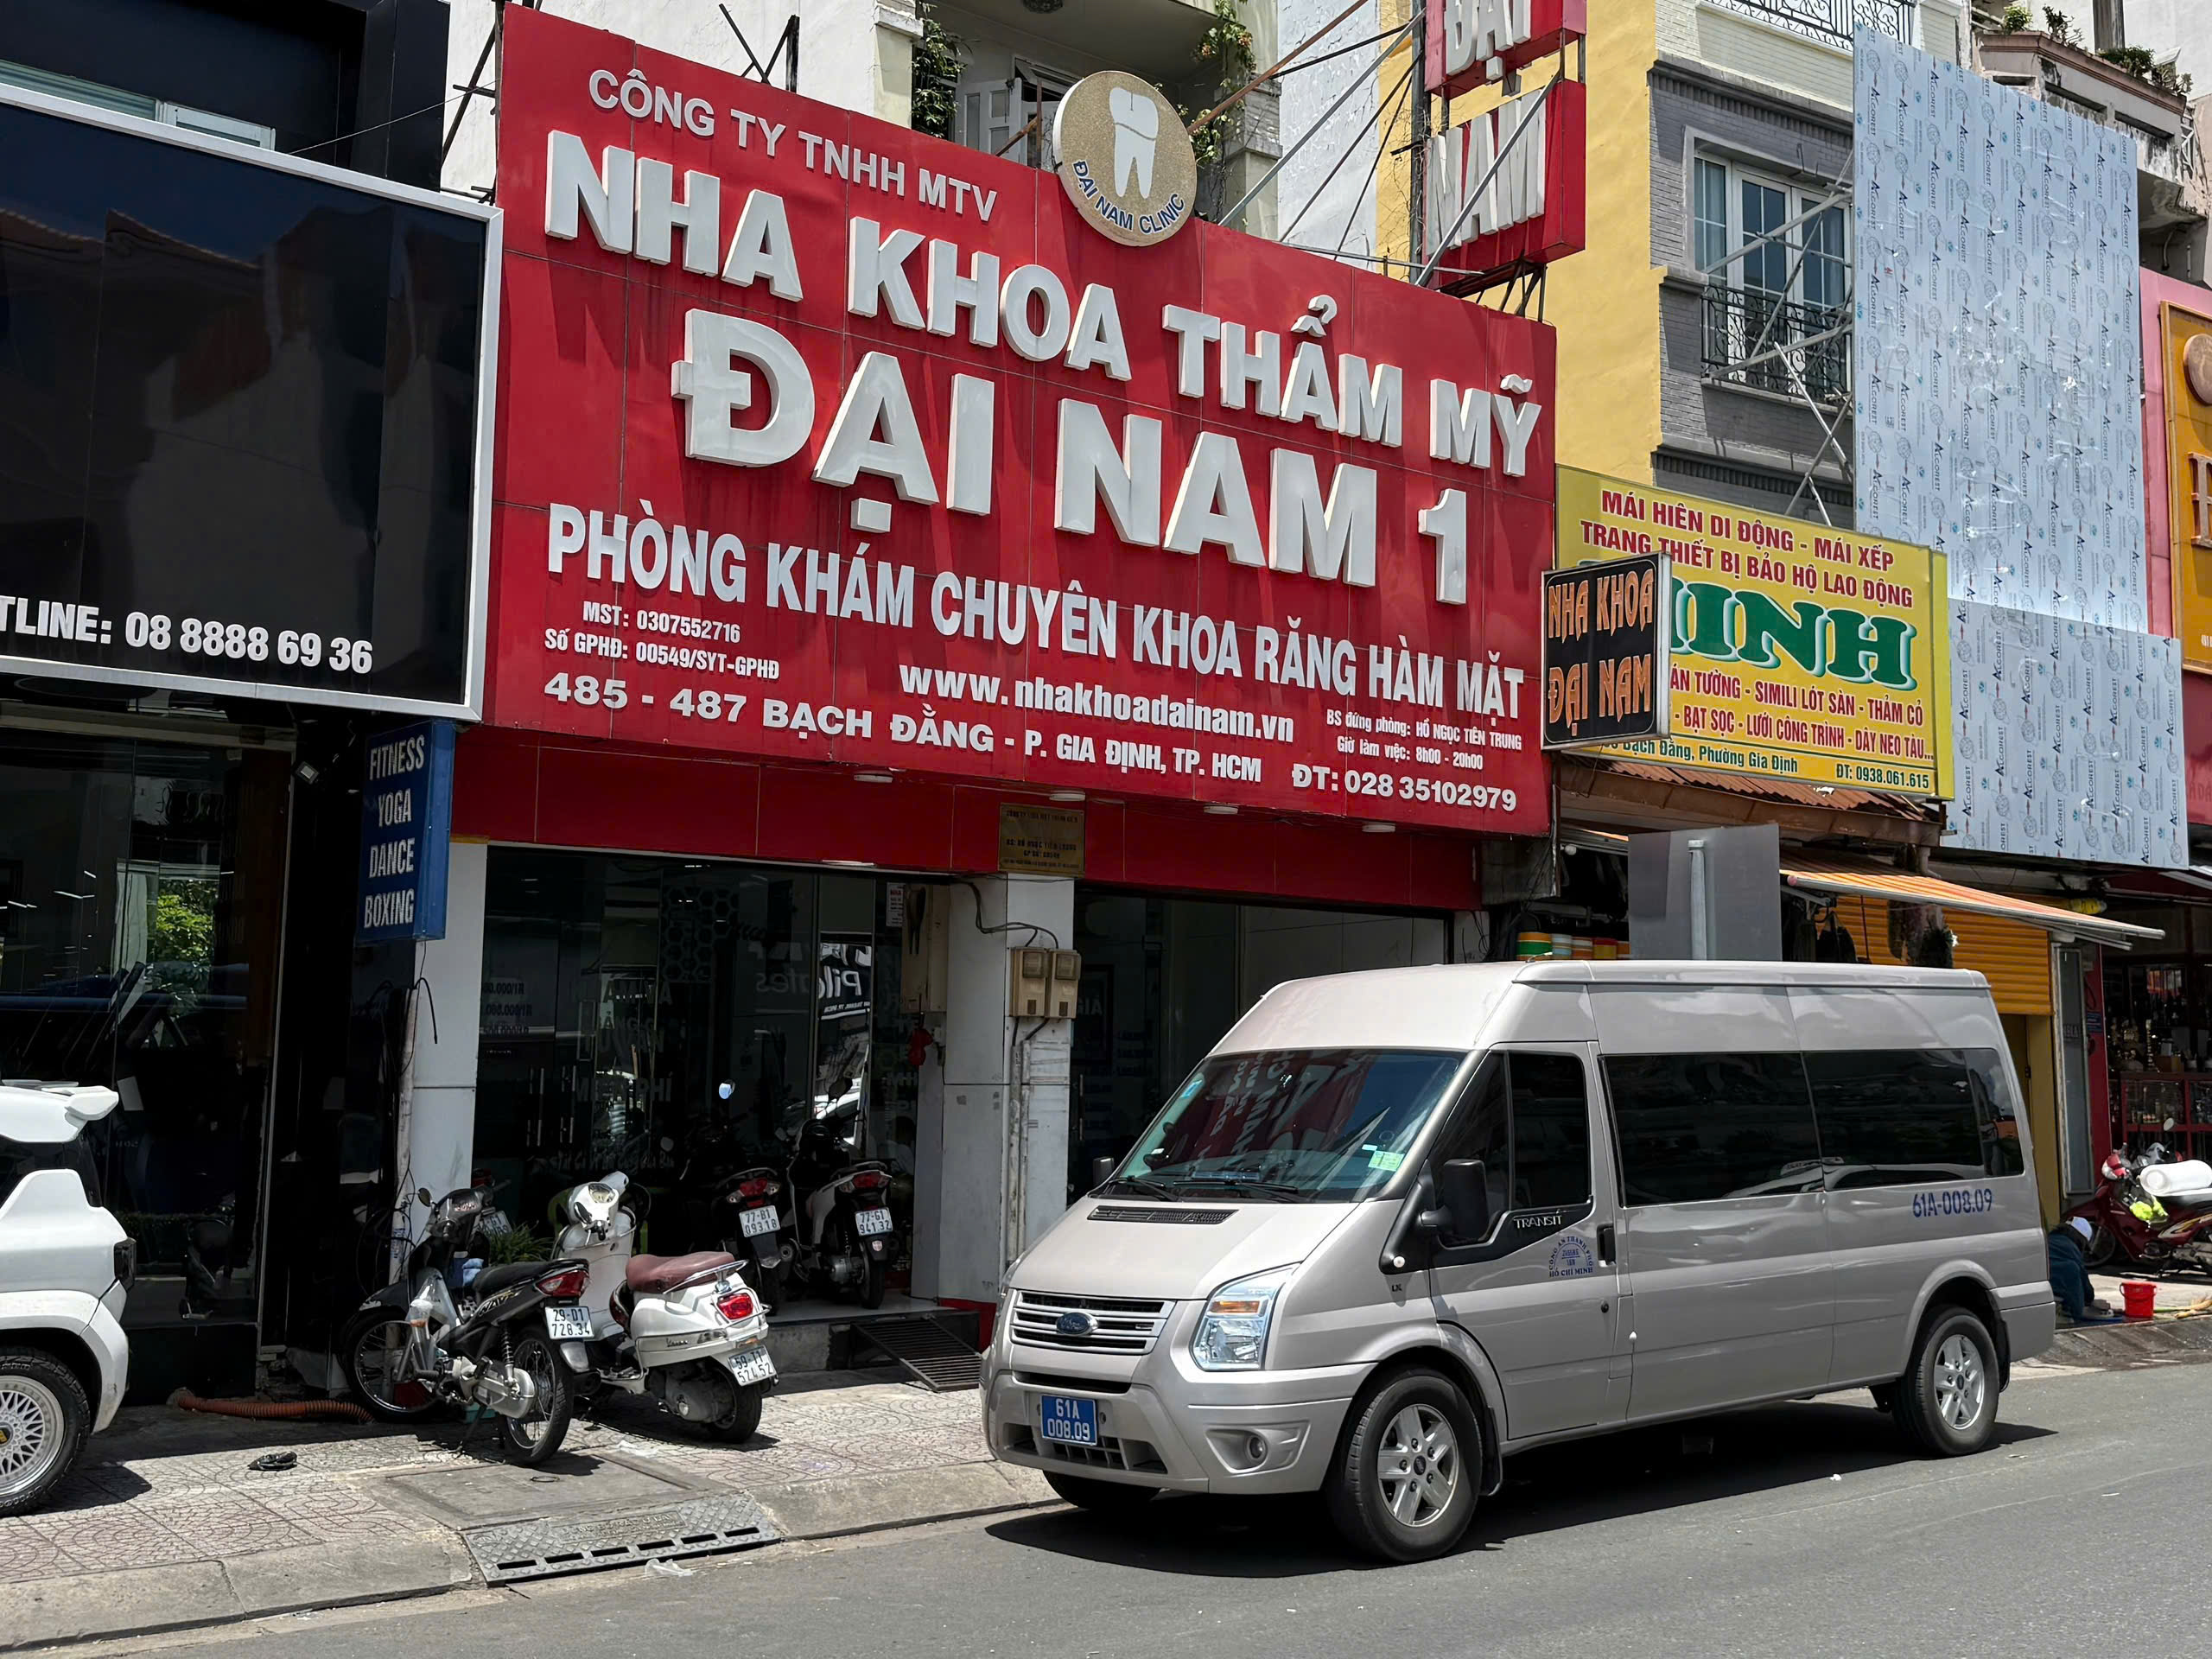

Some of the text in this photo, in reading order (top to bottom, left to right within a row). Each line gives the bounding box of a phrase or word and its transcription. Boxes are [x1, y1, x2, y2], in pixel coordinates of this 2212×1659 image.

[589, 69, 997, 221] CÔNG TY TNHH MTV
[1072, 159, 1185, 234] ĐẠI NAM CLINIC
[545, 130, 1541, 477] NHA KHOA THẨM MỸ
[671, 308, 1466, 605] ĐẠI NAM 1
[1601, 490, 1645, 521] MÁI
[1653, 502, 1703, 533] HIÊN
[1710, 514, 1731, 539] DI
[1738, 519, 1794, 552] ĐỘNG
[1815, 537, 1852, 563] MÁI
[1858, 544, 1894, 571] XẾP
[1580, 520, 1913, 607] TRANG THIẾT BỊ BẢO HỘ LAO ĐỘNG
[548, 499, 1524, 727] PHÒNG KHÁM CHUYÊN KHOA RĂNG HÀM MẶT
[583, 601, 741, 644] MST: 0307552716
[1548, 569, 1654, 644] NHA KHOA
[125, 612, 172, 650] 08
[180, 618, 269, 661] 8888
[277, 630, 322, 667] 69
[329, 637, 373, 674] 36
[544, 627, 779, 680] Số GPHĐ: 00549/SYT-GPHĐ
[899, 664, 1294, 743] www.nhakhoadainam.vn
[1548, 654, 1651, 736] ĐẠI NAM
[1694, 670, 1741, 699] TƯỜNG
[1755, 681, 1797, 709] SIMILI
[1802, 685, 1824, 711] LÓT
[1828, 689, 1855, 716] SÀN
[1867, 695, 1903, 723] THẢM
[1906, 699, 1923, 727] CỎ
[544, 672, 628, 709] 485
[670, 688, 747, 722] 487
[763, 698, 873, 740] BẠCH
[889, 702, 994, 753] ĐẰNG
[1025, 730, 1046, 758] P.
[1056, 735, 1096, 764] GIA
[1105, 739, 1166, 774] ĐỊNH,
[1173, 747, 1205, 776] TP.
[1211, 753, 1262, 783] HCM
[1327, 709, 1342, 726] BS
[1345, 711, 1372, 732] đứng
[1376, 716, 1410, 737] phòng:
[1433, 724, 1460, 745] NGỌC
[1489, 731, 1522, 751] TRUNG
[1684, 705, 1707, 734] BẠT
[1711, 710, 1734, 737] SỌC
[1746, 712, 1772, 739] LƯỚI
[1777, 717, 1808, 744] CÔNG
[1811, 721, 1844, 748] TRÌNH
[1855, 728, 1876, 753] DÂY
[1879, 734, 1901, 756] NEO
[369, 734, 425, 780] FITNESS
[1337, 736, 1355, 753] Giờ
[1360, 739, 1379, 757] làm
[1416, 747, 1440, 766] 8h00
[1452, 752, 1483, 770] 20h00
[1700, 747, 1745, 767] Phường
[1749, 752, 1768, 769] Gia
[1771, 756, 1798, 774] Định
[1292, 763, 1516, 811] ĐT: 028 35102979
[1836, 764, 1929, 789] ĐT: 0938.061.615
[378, 788, 412, 827] YOGA
[369, 837, 416, 879] DANCE
[364, 888, 415, 929] BOXING
[746, 1210, 771, 1224] 77-B1
[861, 1211, 885, 1224] 77-G1
[1514, 1215, 1562, 1229] TRANSIT
[1912, 1188, 1993, 1217] 61A-008.09
[745, 1218, 778, 1235] 093.18
[552, 1322, 591, 1337] 728.34
[553, 1308, 583, 1322] 29-D1
[1047, 1418, 1090, 1440] 008.09
[1056, 1399, 1080, 1420] 61A
